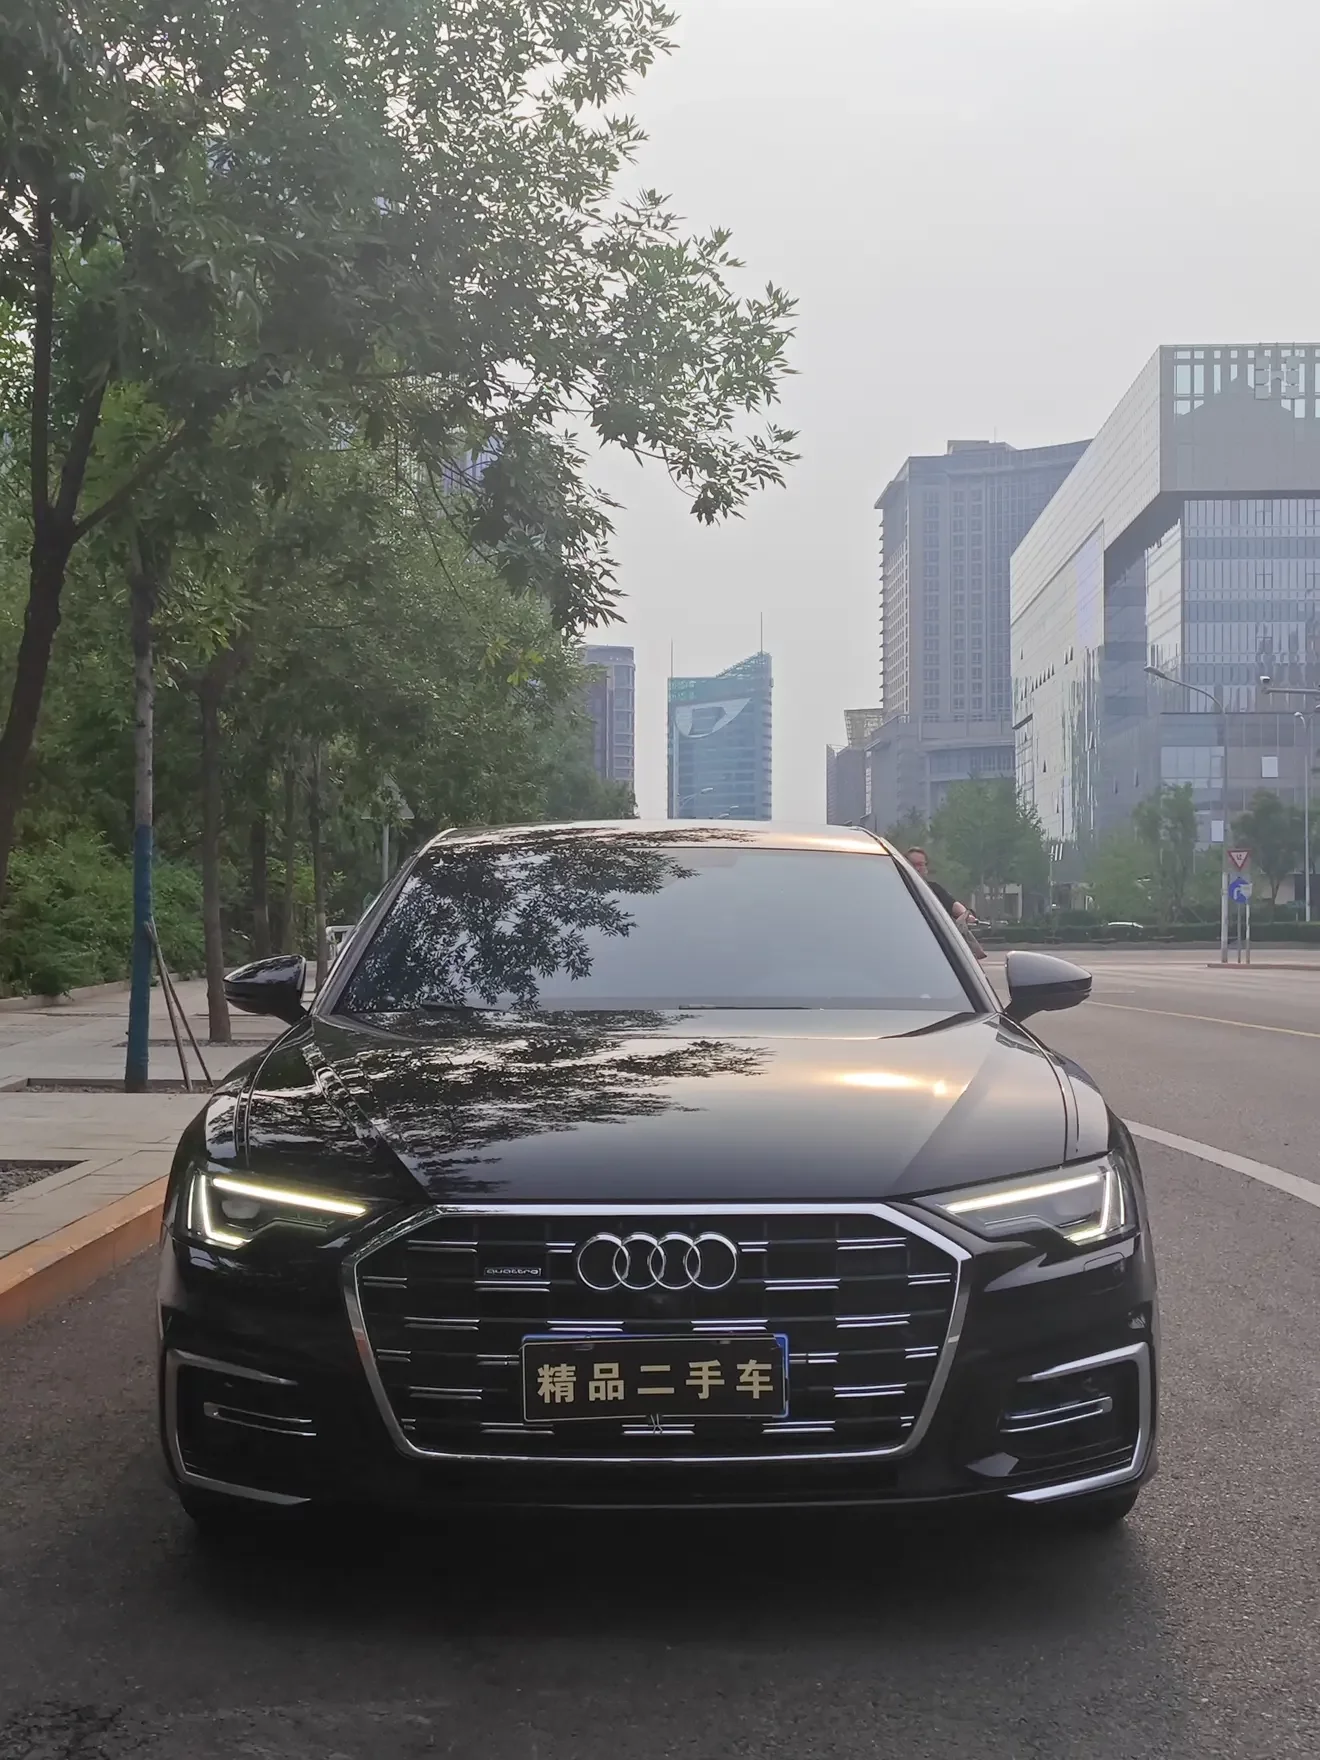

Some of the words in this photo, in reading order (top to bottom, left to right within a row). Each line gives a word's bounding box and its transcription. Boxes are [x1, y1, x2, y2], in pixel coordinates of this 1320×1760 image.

[537, 1359, 774, 1404] 精品二手车
